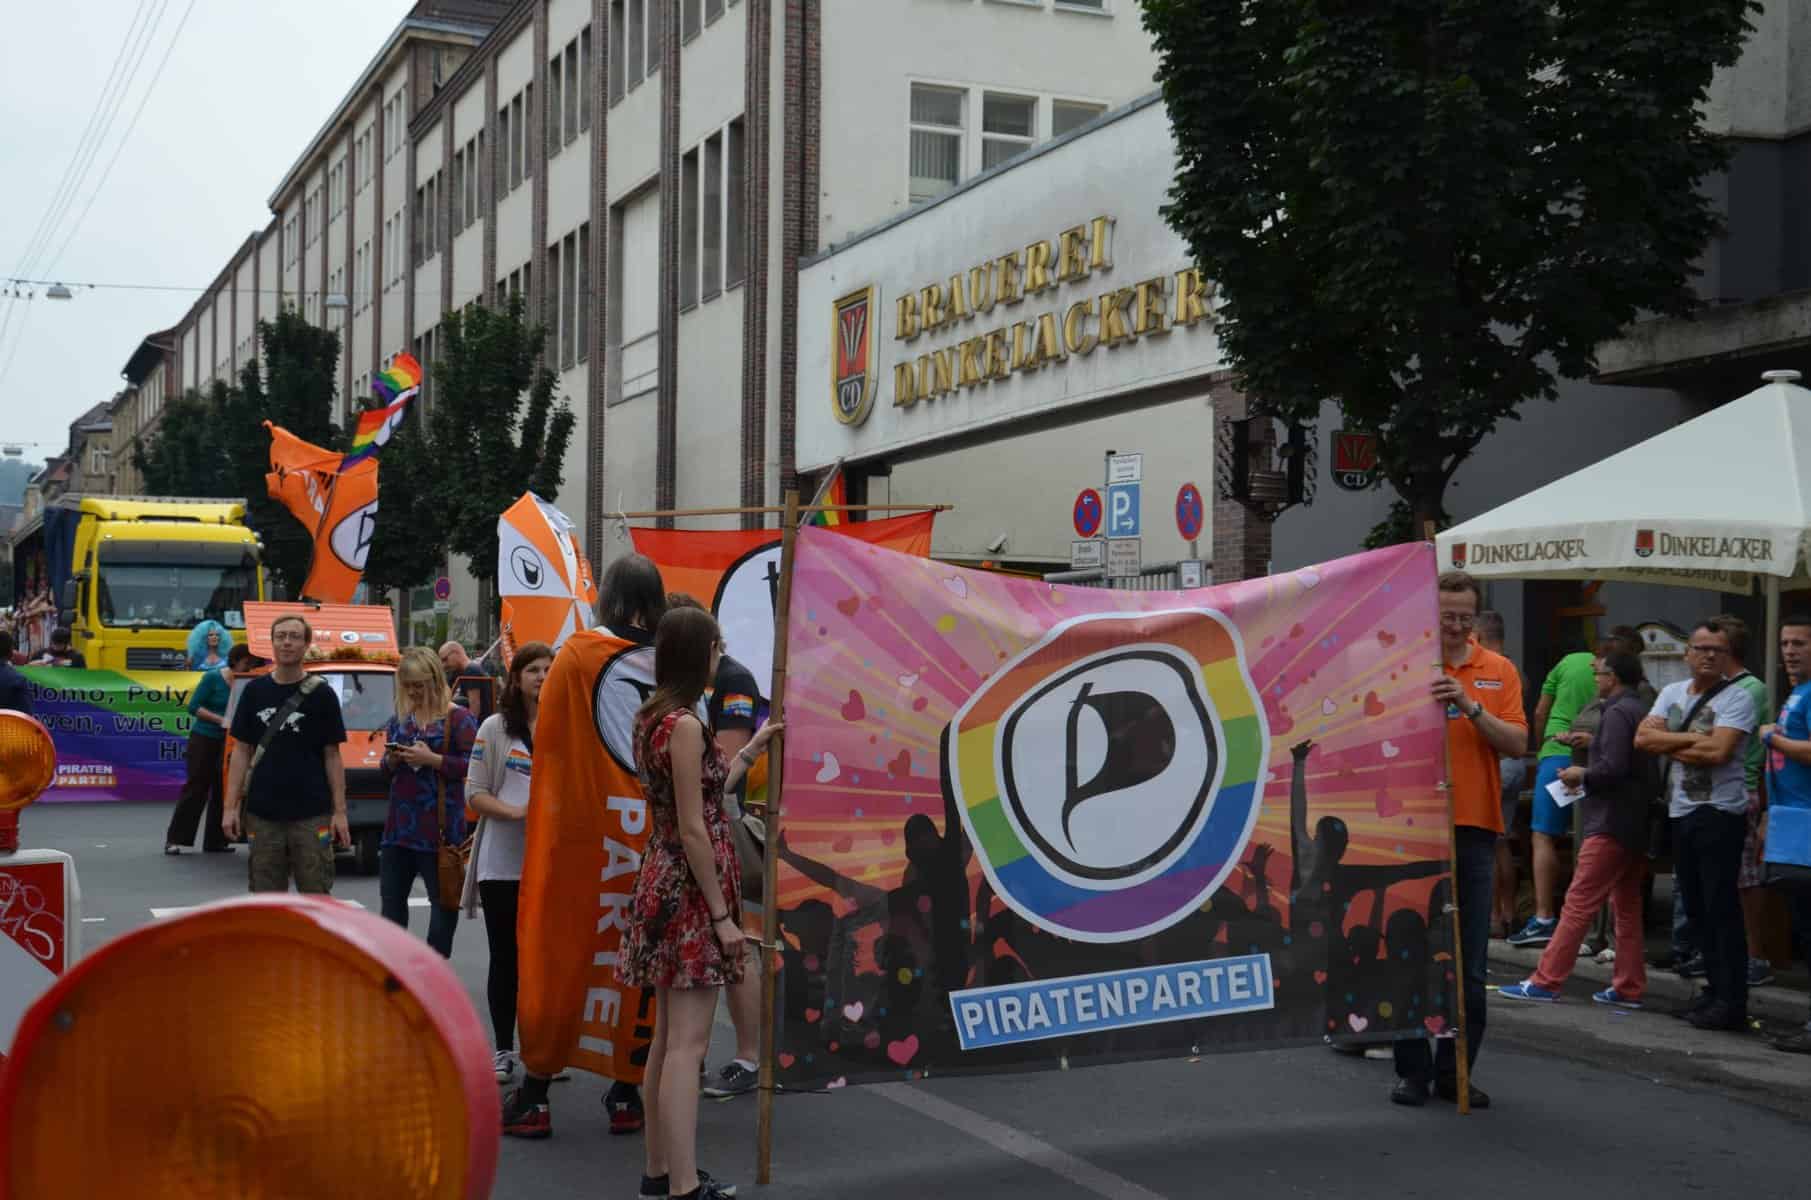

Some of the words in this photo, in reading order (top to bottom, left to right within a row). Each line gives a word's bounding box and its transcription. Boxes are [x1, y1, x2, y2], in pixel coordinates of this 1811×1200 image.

[894, 215, 1117, 341] BRAUEREI
[893, 267, 1217, 408] DINKELACKER
[840, 381, 861, 411] CD
[1112, 490, 1131, 531] P
[128, 685, 189, 708] Poly
[113, 711, 163, 732] wie
[58, 764, 113, 774] PIRATEN
[58, 775, 113, 785] PARTEI
[960, 961, 1265, 1040] PIRATENPARTEI
